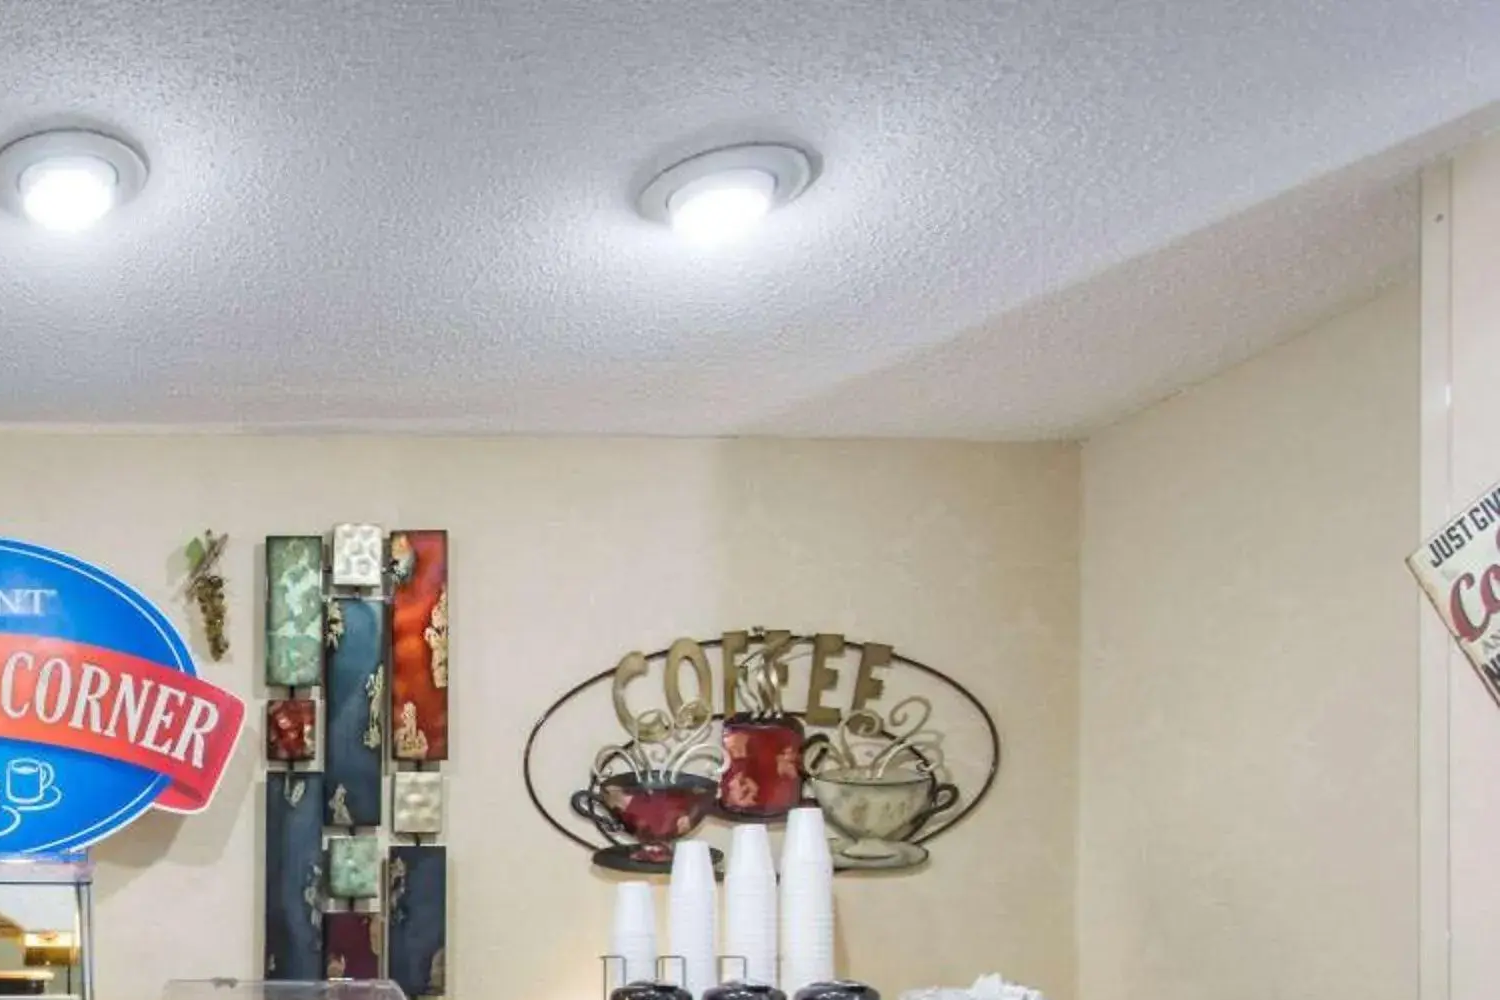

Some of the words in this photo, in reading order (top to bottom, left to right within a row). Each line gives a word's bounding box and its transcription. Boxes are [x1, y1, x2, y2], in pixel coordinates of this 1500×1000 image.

[1427, 515, 1474, 568] JUST
[1468, 487, 1500, 532] GIV
[1450, 562, 1500, 642] Co
[0, 649, 222, 770] CORNER
[611, 630, 895, 741] COFFEE
